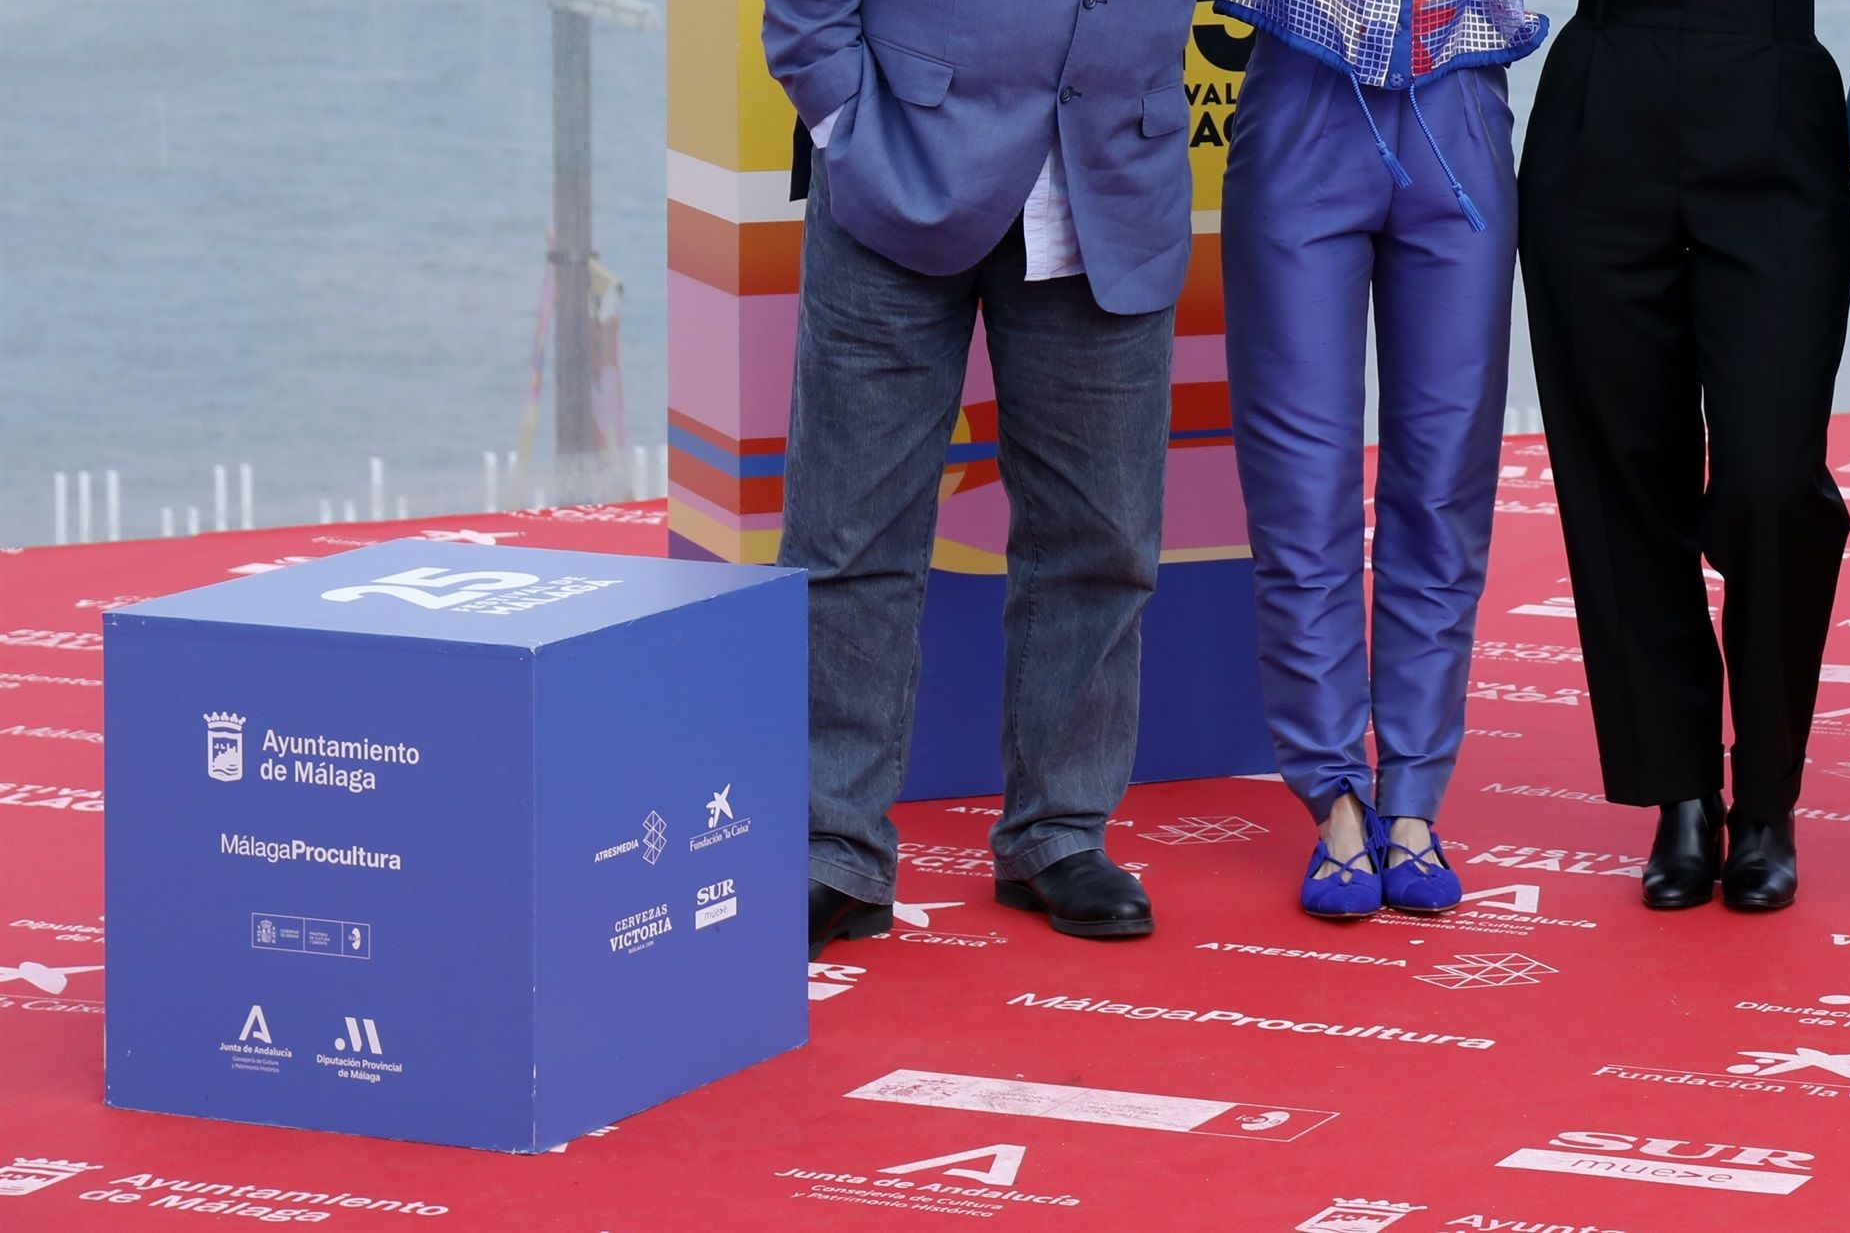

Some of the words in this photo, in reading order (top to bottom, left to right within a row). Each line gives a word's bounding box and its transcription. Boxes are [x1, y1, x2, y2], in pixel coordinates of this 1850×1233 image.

[320, 567, 540, 610] 25
[262, 729, 420, 765] Ayuntamiento
[260, 758, 287, 781] de
[294, 760, 376, 793] Málaga
[221, 833, 401, 870] MálagaProcultura
[594, 839, 639, 863] ATRESMEDIA
[690, 834, 723, 852] Fundación
[696, 878, 735, 905] SUR
[614, 904, 668, 933] CERVEZAS
[1459, 910, 1597, 929] Andalucía
[1478, 921, 1535, 930] Cultura
[609, 917, 673, 952] VICTORIA
[1196, 941, 1408, 968] ATRESMEDIA
[1006, 992, 1497, 1049] MálagaProcultura
[1798, 1016, 1839, 1027] de
[220, 1042, 242, 1053] Junta
[242, 1044, 253, 1053] de
[253, 1045, 293, 1057] Andalucía
[317, 1054, 361, 1069] Diputación
[361, 1059, 402, 1073] Provincial
[338, 1068, 348, 1078] de
[350, 1069, 381, 1084] Málaga
[1591, 1065, 1787, 1094] Fundación
[1548, 1130, 1817, 1170] SUR
[109, 1172, 450, 1217] Ayuntamiento
[774, 1167, 868, 1184] Junta
[873, 1178, 915, 1189] de
[917, 1182, 1081, 1207] Andalucía
[810, 1184, 906, 1200] Consejería
[908, 1193, 933, 1203] de
[936, 1195, 1004, 1210] Cultura
[79, 1188, 142, 1204] de
[149, 1193, 333, 1223] Málaga
[807, 1191, 908, 1209] Patrimonio
[910, 1202, 994, 1218] Histórico
